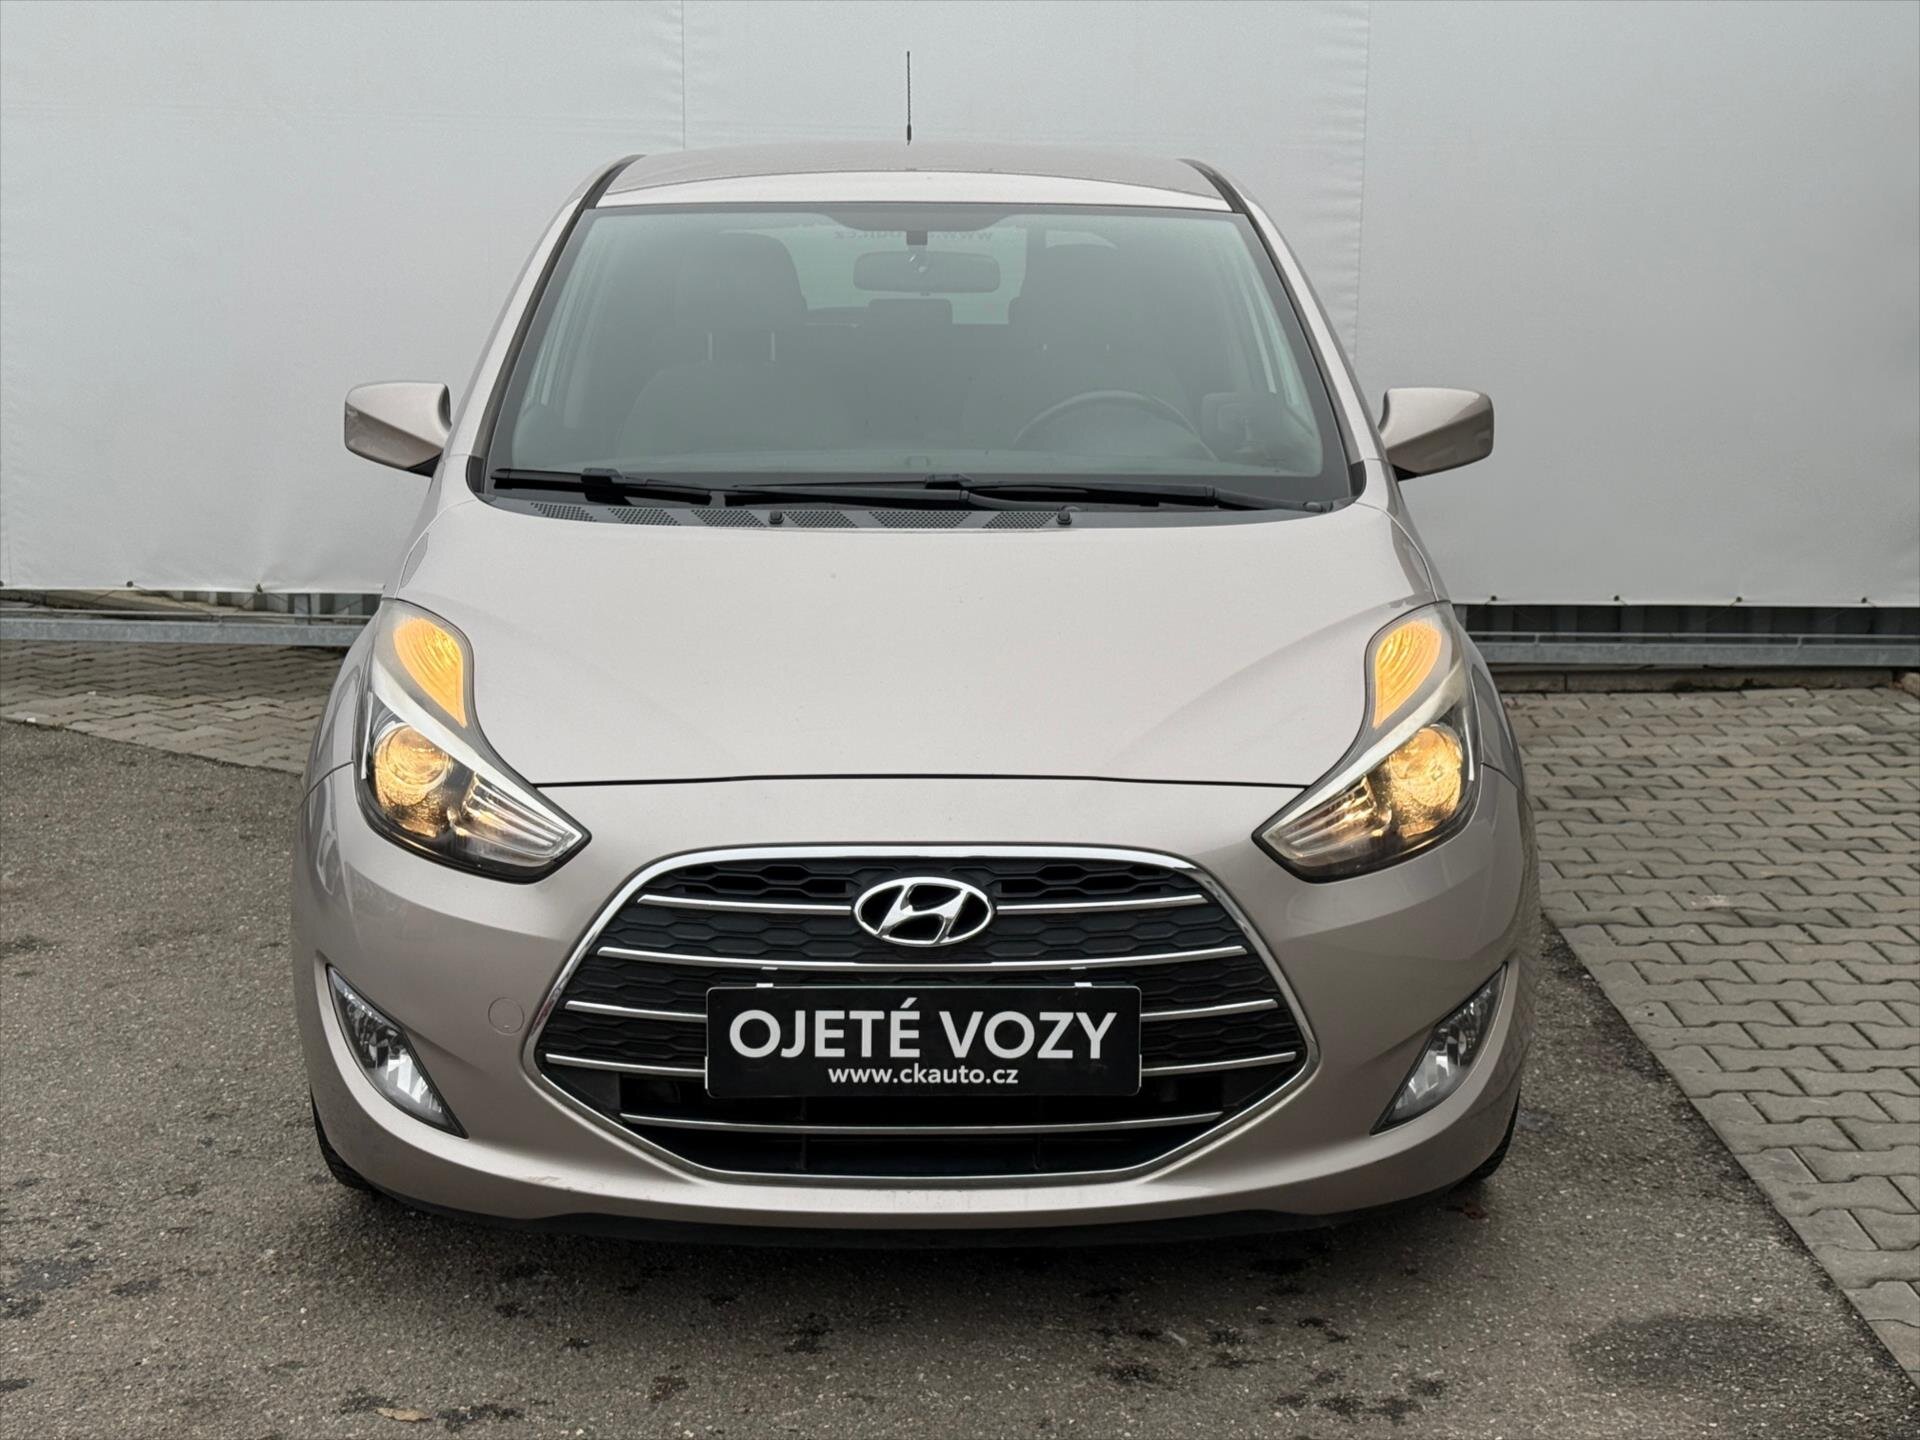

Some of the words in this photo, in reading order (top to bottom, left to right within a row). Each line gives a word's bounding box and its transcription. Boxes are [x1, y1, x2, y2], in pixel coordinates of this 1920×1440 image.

[729, 997, 921, 1059] OJETÉ
[939, 1011, 1117, 1059] VOZY
[828, 1064, 1019, 1085] www.ckauto.cz
